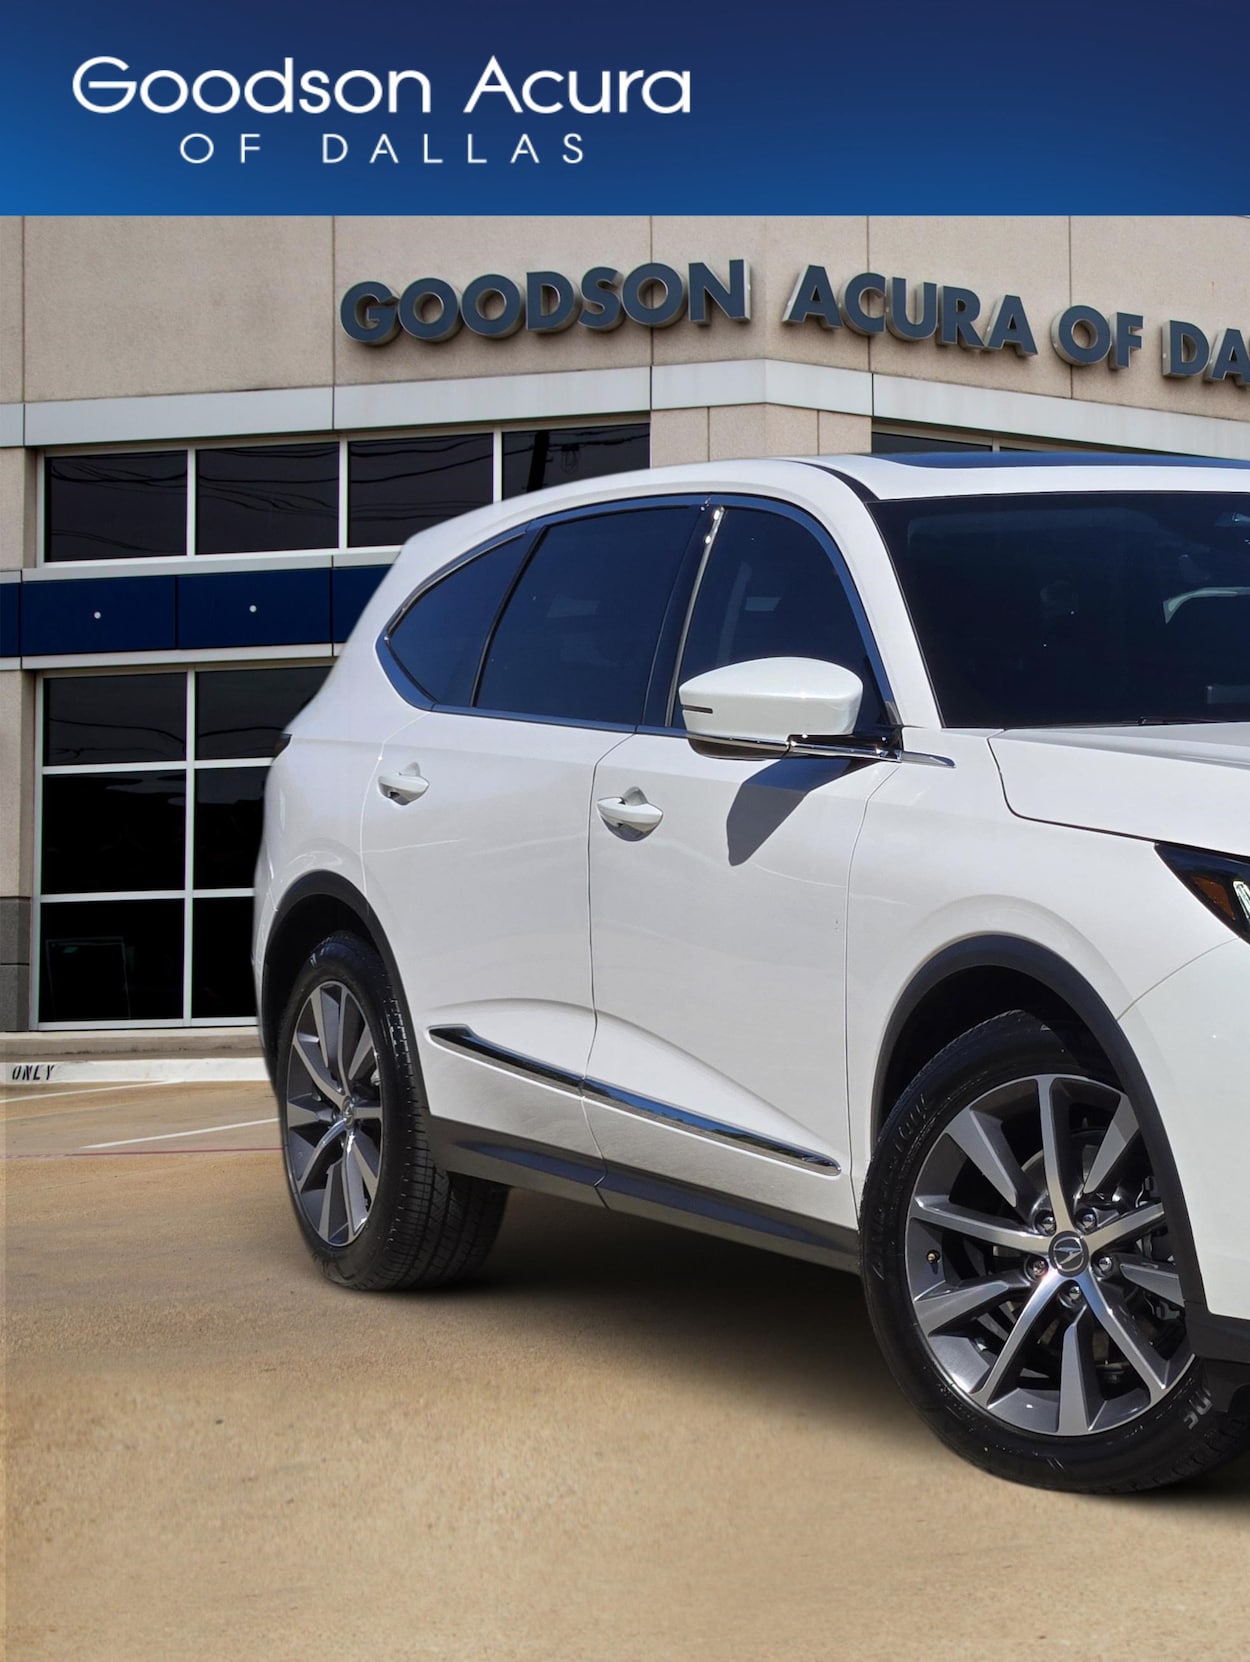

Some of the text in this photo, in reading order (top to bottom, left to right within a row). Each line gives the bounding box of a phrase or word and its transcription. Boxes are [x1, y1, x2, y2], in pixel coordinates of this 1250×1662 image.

[340, 259, 751, 345] GOODSON
[782, 264, 1038, 356] ACURA
[1051, 305, 1144, 370] OF
[12, 1064, 55, 1081] ONLY
